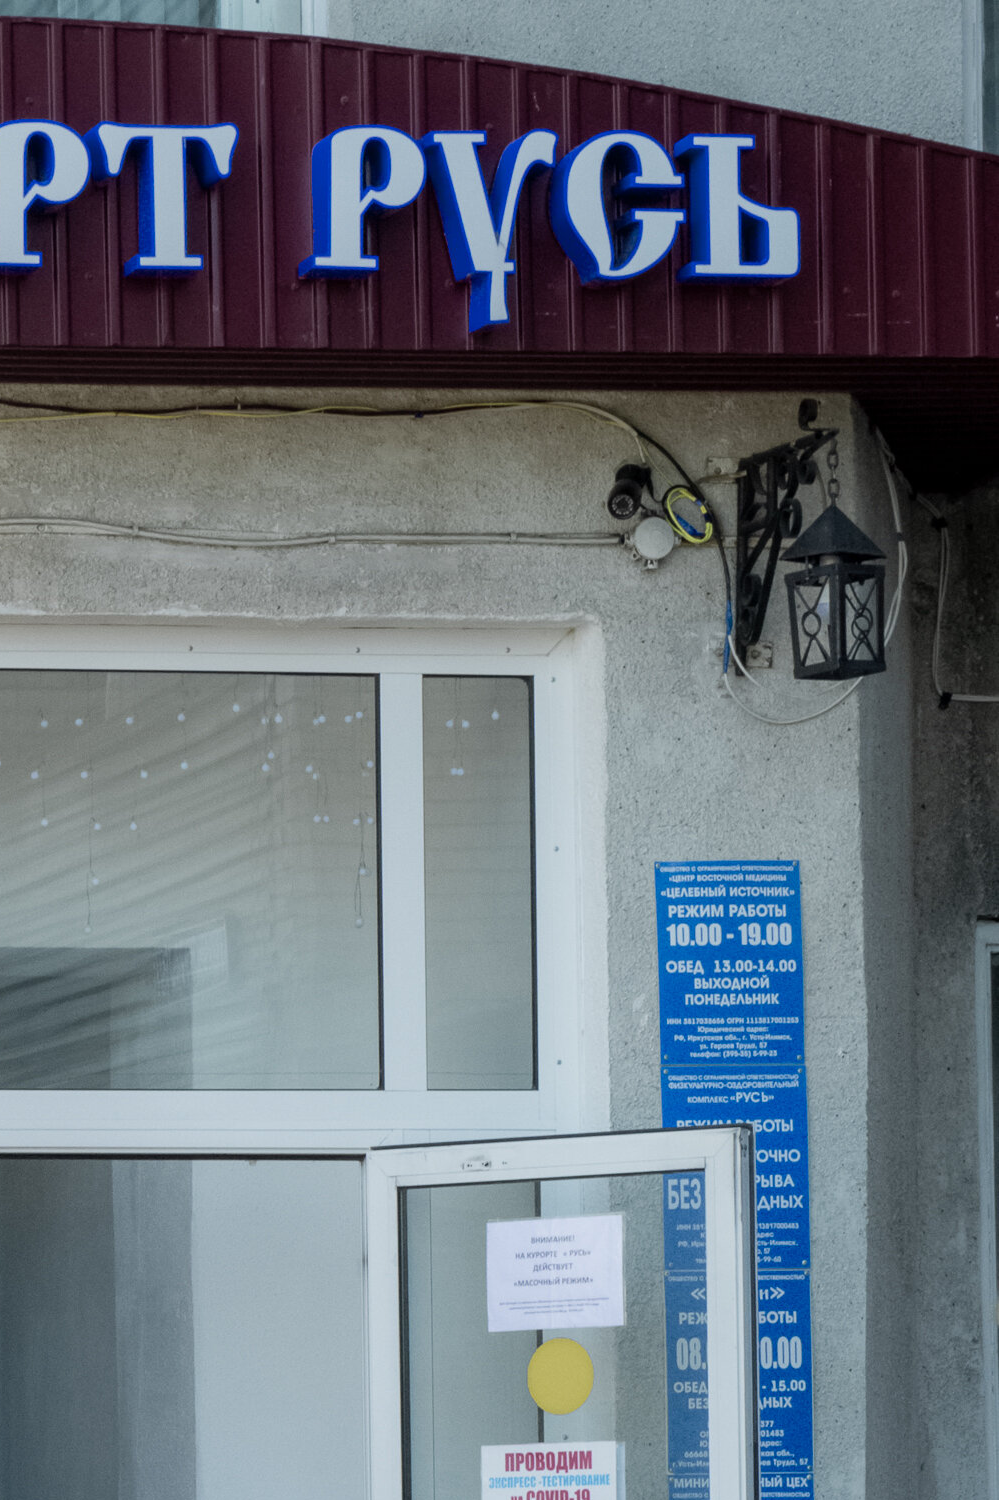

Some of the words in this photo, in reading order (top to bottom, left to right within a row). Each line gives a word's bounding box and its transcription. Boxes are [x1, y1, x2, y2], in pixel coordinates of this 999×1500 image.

[298, 125, 801, 332] РУСЬ
[697, 873, 743, 882] ВОСТОЧНОЙ
[745, 874, 787, 882] МЕДИЦИНЫ
[660, 885, 726, 899] «ЦЕЛЕБНЫЙ
[730, 886, 795, 897] ИСТОЧНИК»
[668, 904, 724, 918] РЕЖИМ
[729, 904, 787, 917] РАБОТЫ
[666, 923, 722, 946] 10.00
[738, 922, 793, 946] 19.00
[666, 960, 704, 975] ОБЕД
[713, 959, 797, 973] 13.00-14.00
[694, 975, 770, 990] ВЫХОДНОЙ
[685, 993, 779, 1007] ПОНЕДЕЛЬНИК
[667, 1178, 701, 1210] БЕЗ
[530, 1235, 575, 1245] ВНИМАНИЕ!
[515, 1252, 526, 1260] НА
[526, 1251, 557, 1259] КУРОРТЕ
[532, 1262, 574, 1272] ДЕЙСТВУЕТ
[676, 1338, 707, 1370] 08.
[759, 1336, 802, 1370] 0.00
[771, 1380, 806, 1392] 15.00
[505, 1450, 593, 1473] ПРОВОДИМ
[489, 1476, 537, 1489] ЭКСПРЕСС
[786, 1477, 808, 1489] ЦЕХ
